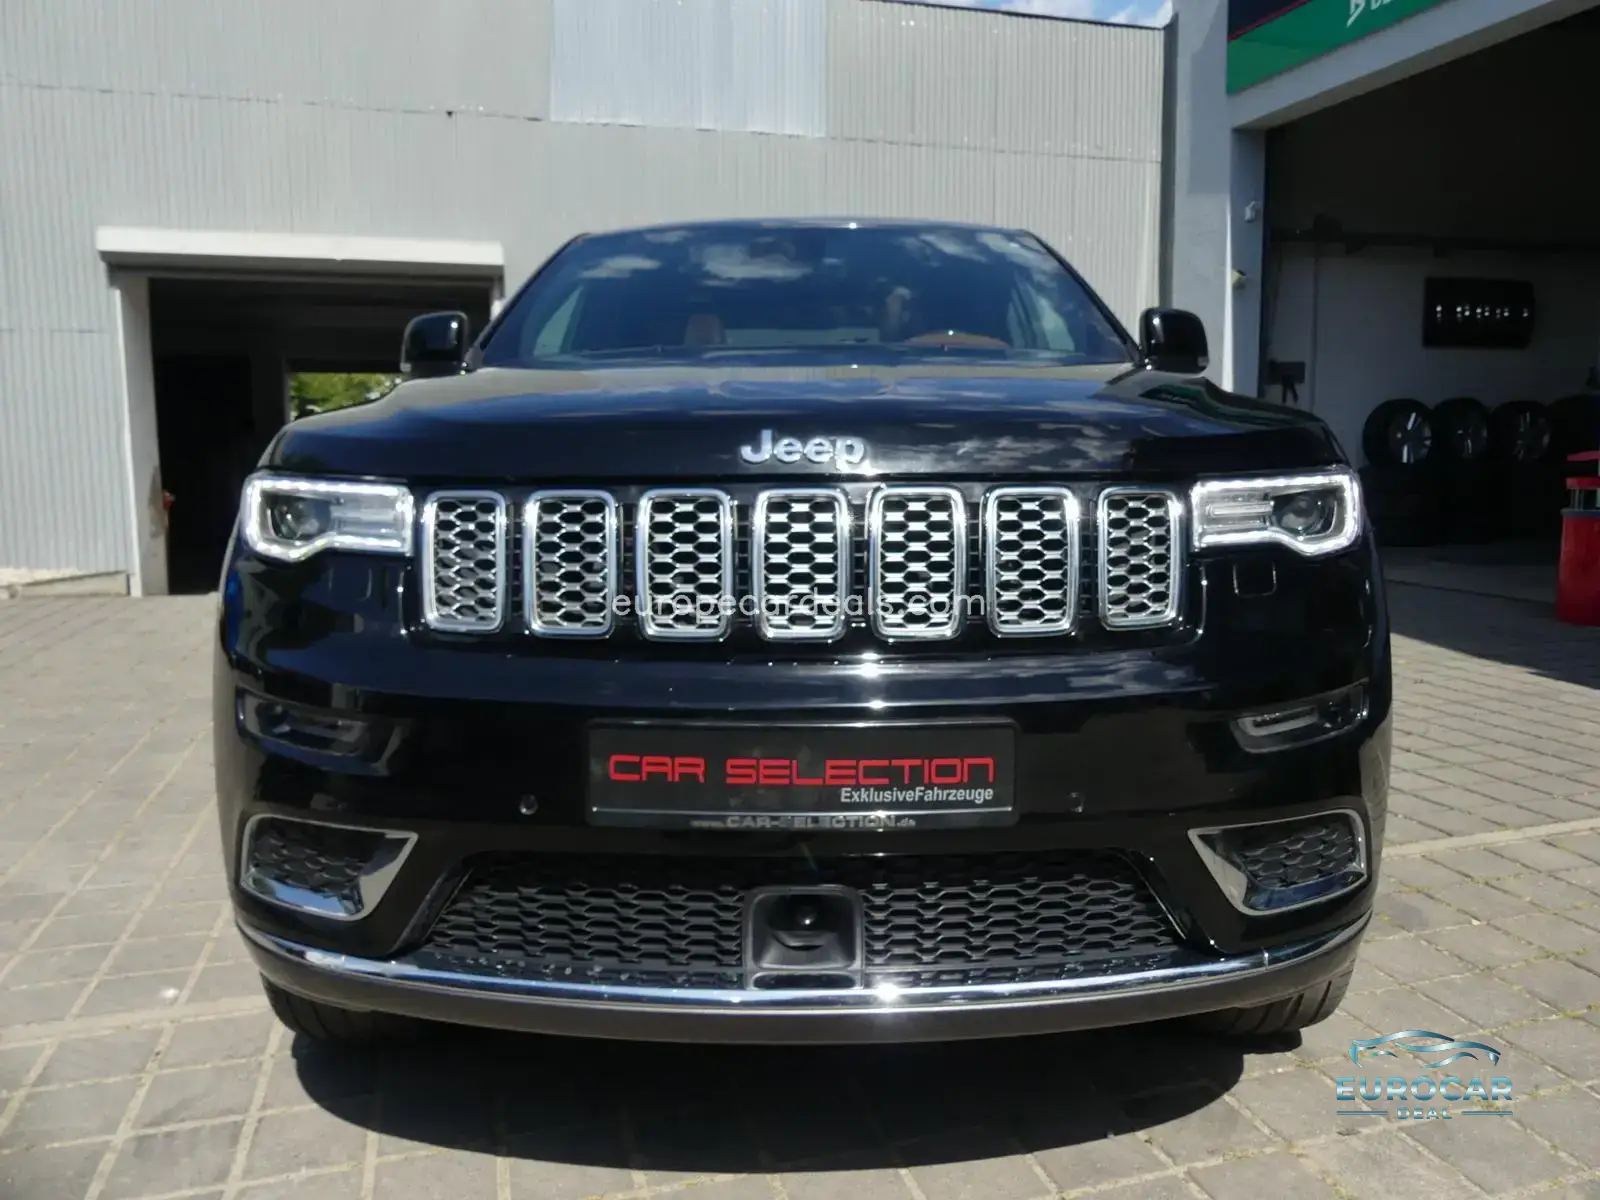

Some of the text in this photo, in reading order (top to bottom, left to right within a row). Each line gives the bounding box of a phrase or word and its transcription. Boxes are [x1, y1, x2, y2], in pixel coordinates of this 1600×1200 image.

[740, 428, 866, 473] Jeep
[608, 754, 995, 785] CAR SELECTION
[840, 786, 995, 804] ExklusiveFahrzeuge
